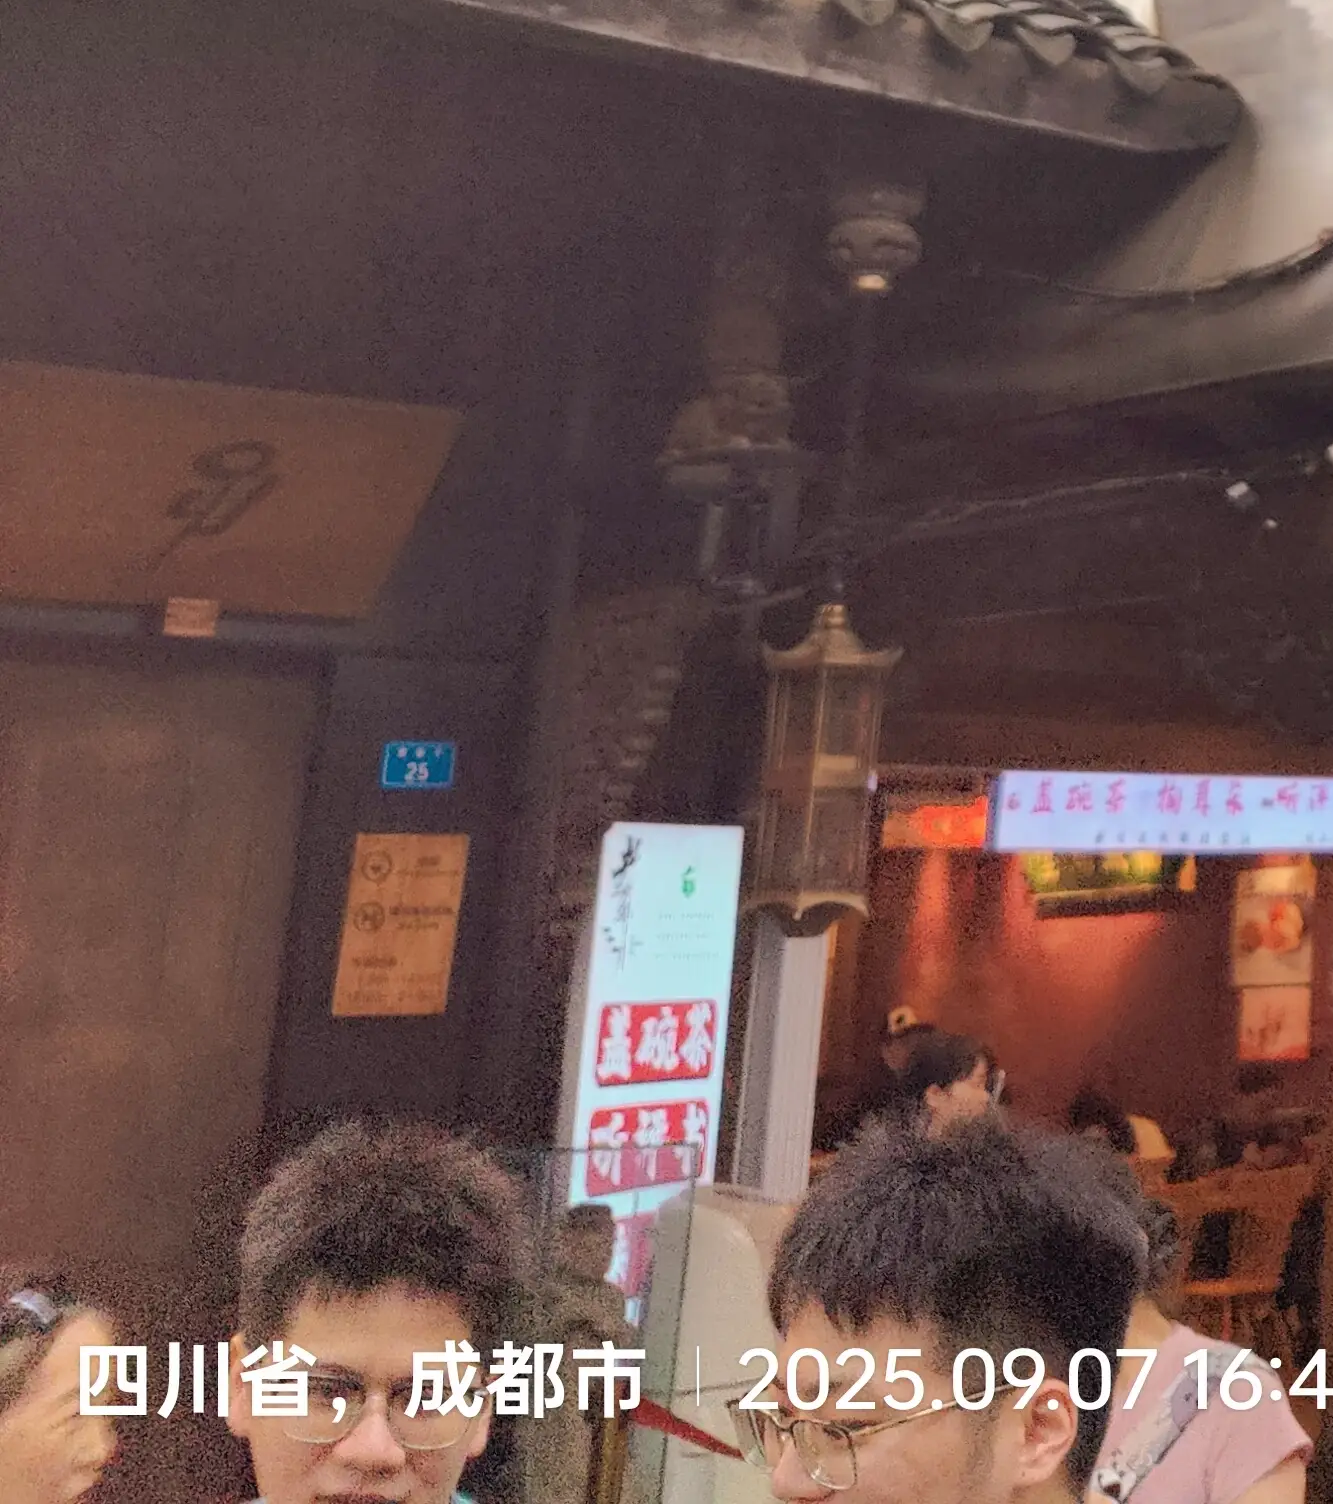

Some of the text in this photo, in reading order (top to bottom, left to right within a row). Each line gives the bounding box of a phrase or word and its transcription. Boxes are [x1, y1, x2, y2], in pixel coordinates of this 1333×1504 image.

[403, 761, 430, 782] 25
[1030, 777, 1128, 815] 盖碗茶
[1156, 777, 1245, 817] 掏耳朵
[597, 1001, 715, 1081] 盖碗茶
